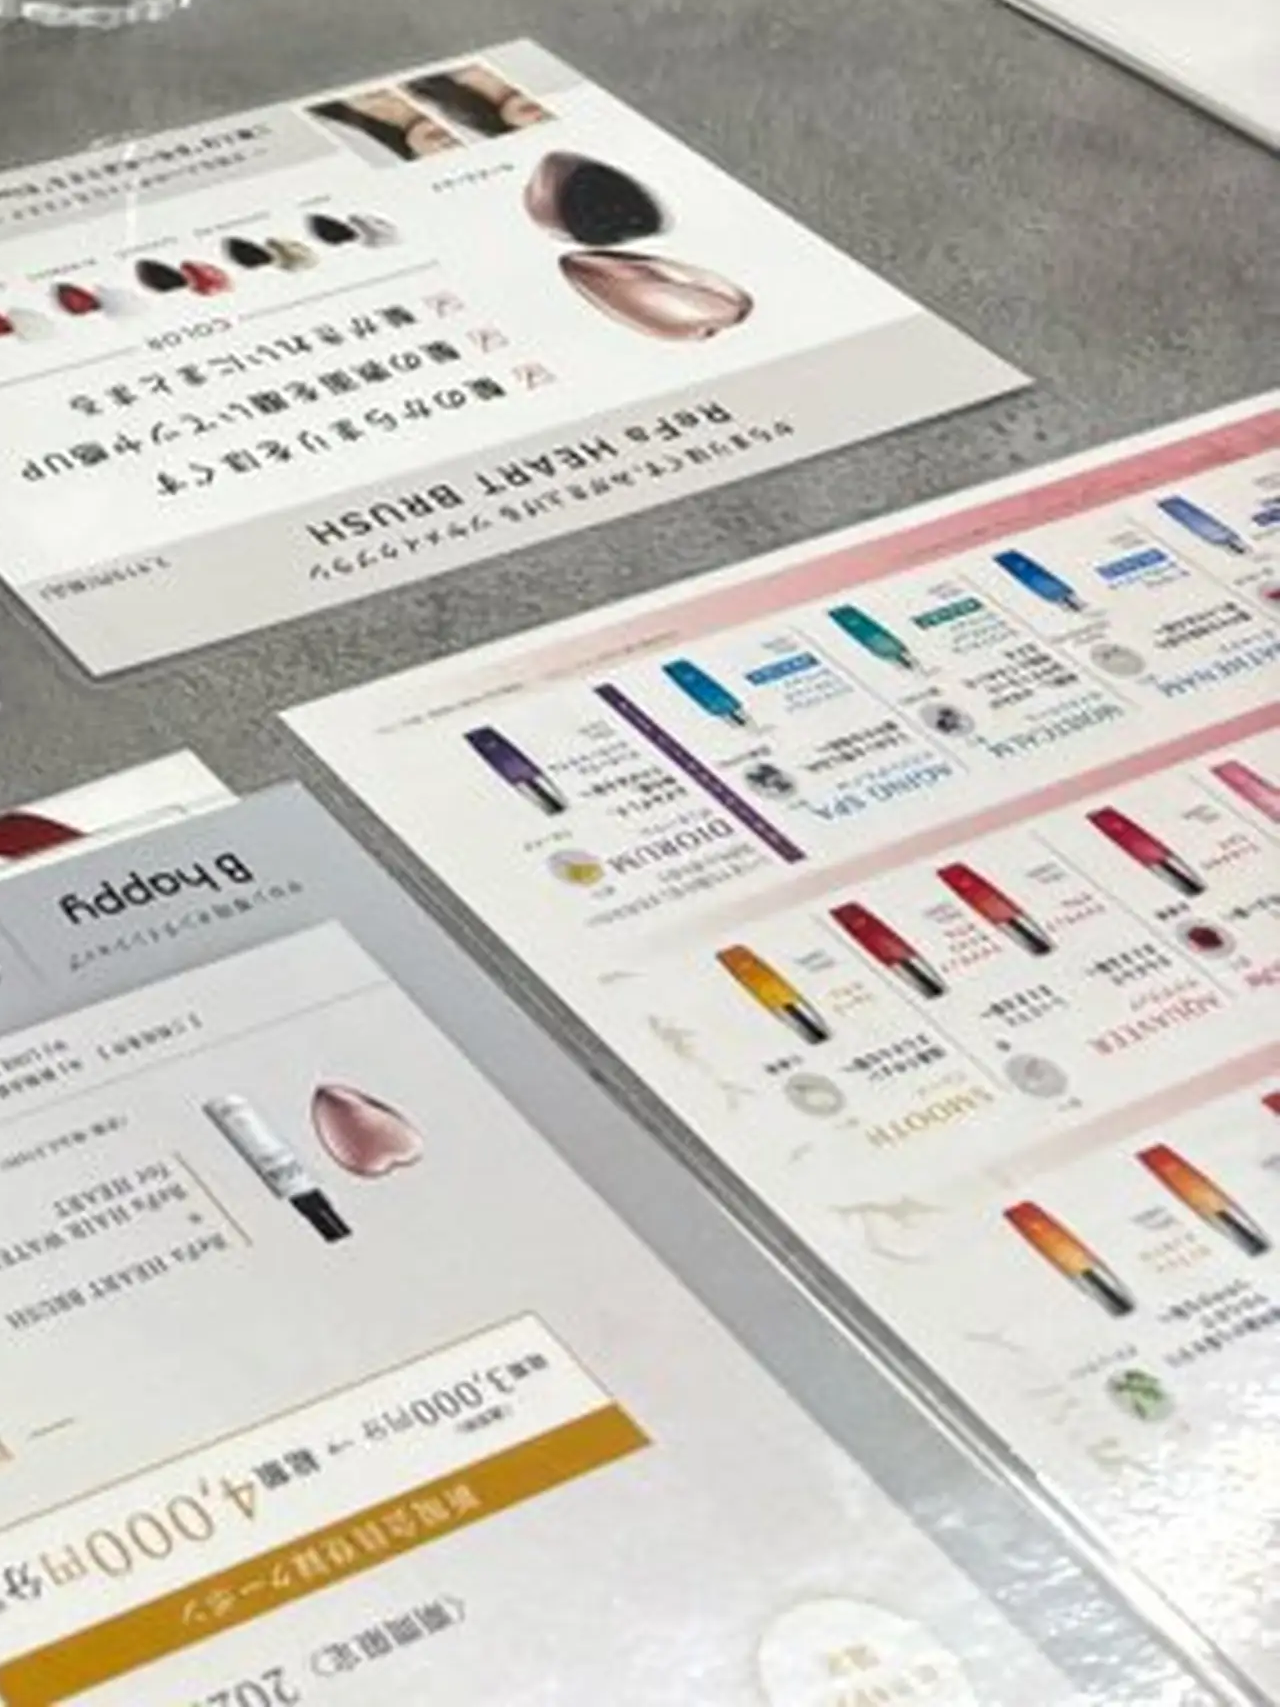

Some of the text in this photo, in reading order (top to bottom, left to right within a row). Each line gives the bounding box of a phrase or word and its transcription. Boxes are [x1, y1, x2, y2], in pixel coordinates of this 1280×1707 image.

[70, 306, 417, 415] 髪がきれいにまとまる
[147, 318, 232, 350] COLOR
[157, 377, 506, 495] 髪のからまりをほぐす
[307, 403, 732, 545] ReFa HEART BRUSH
[59, 853, 253, 924] B happy
[607, 819, 735, 874] DIORUM
